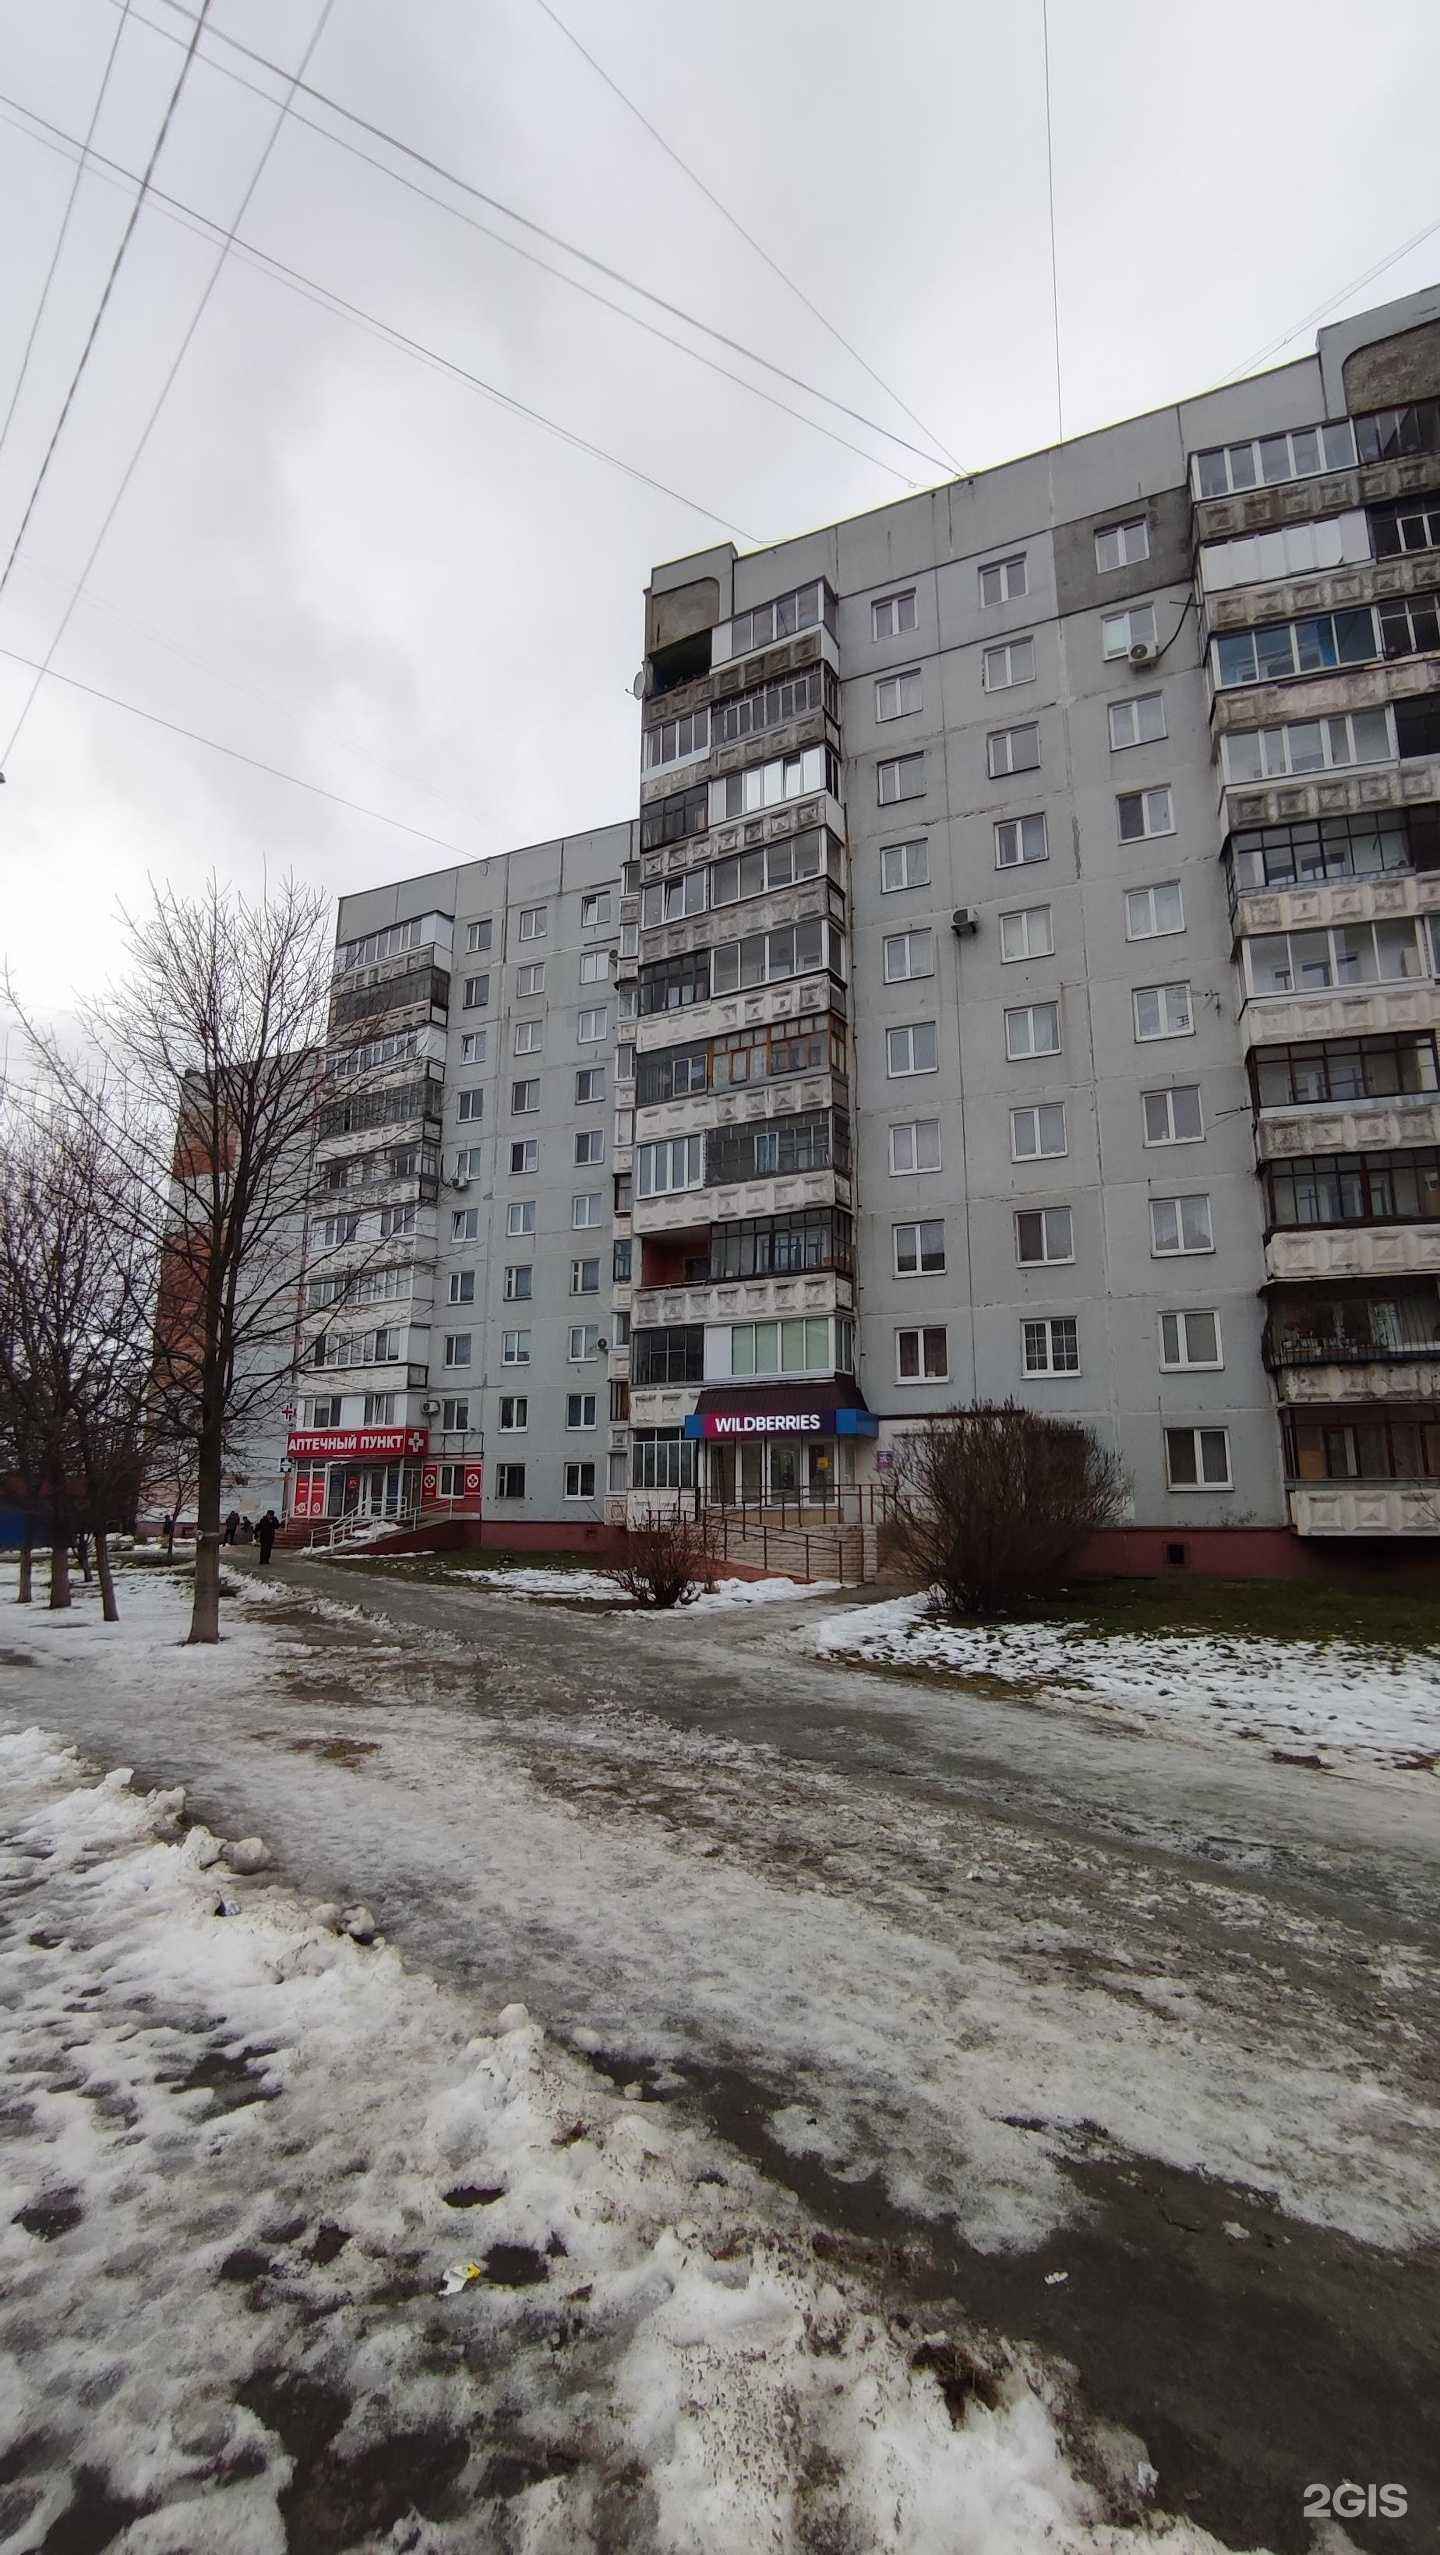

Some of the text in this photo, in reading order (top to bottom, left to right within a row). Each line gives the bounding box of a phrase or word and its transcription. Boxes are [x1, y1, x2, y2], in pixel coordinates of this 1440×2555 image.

[715, 1414, 821, 1433] WILDBERRIES
[288, 1434, 404, 1451] АПТЕЧНЫЙ ПУНКТ
